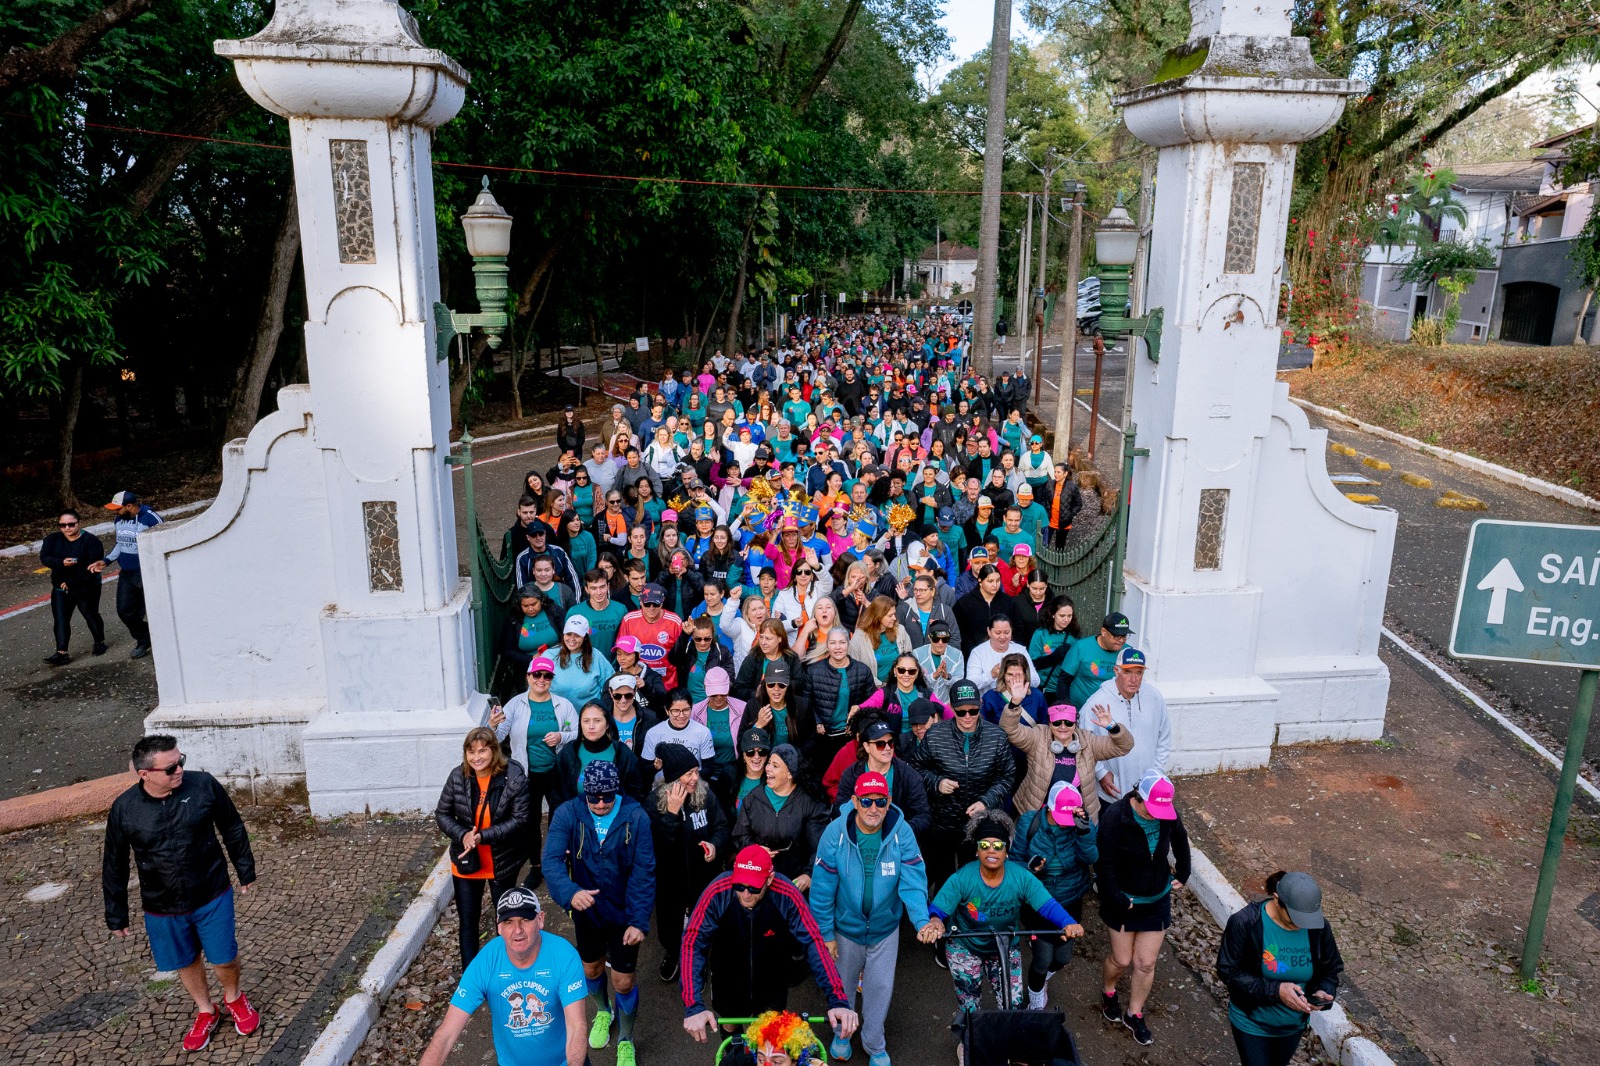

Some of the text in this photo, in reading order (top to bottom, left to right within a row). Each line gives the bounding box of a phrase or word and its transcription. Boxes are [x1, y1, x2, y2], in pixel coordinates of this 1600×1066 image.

[1537, 549, 1600, 586] SAÍ
[1526, 606, 1599, 646] Eng.
[989, 906, 1014, 917] BEM
[501, 981, 523, 998] PERNAS
[523, 980, 550, 997] CAIPIRAS
